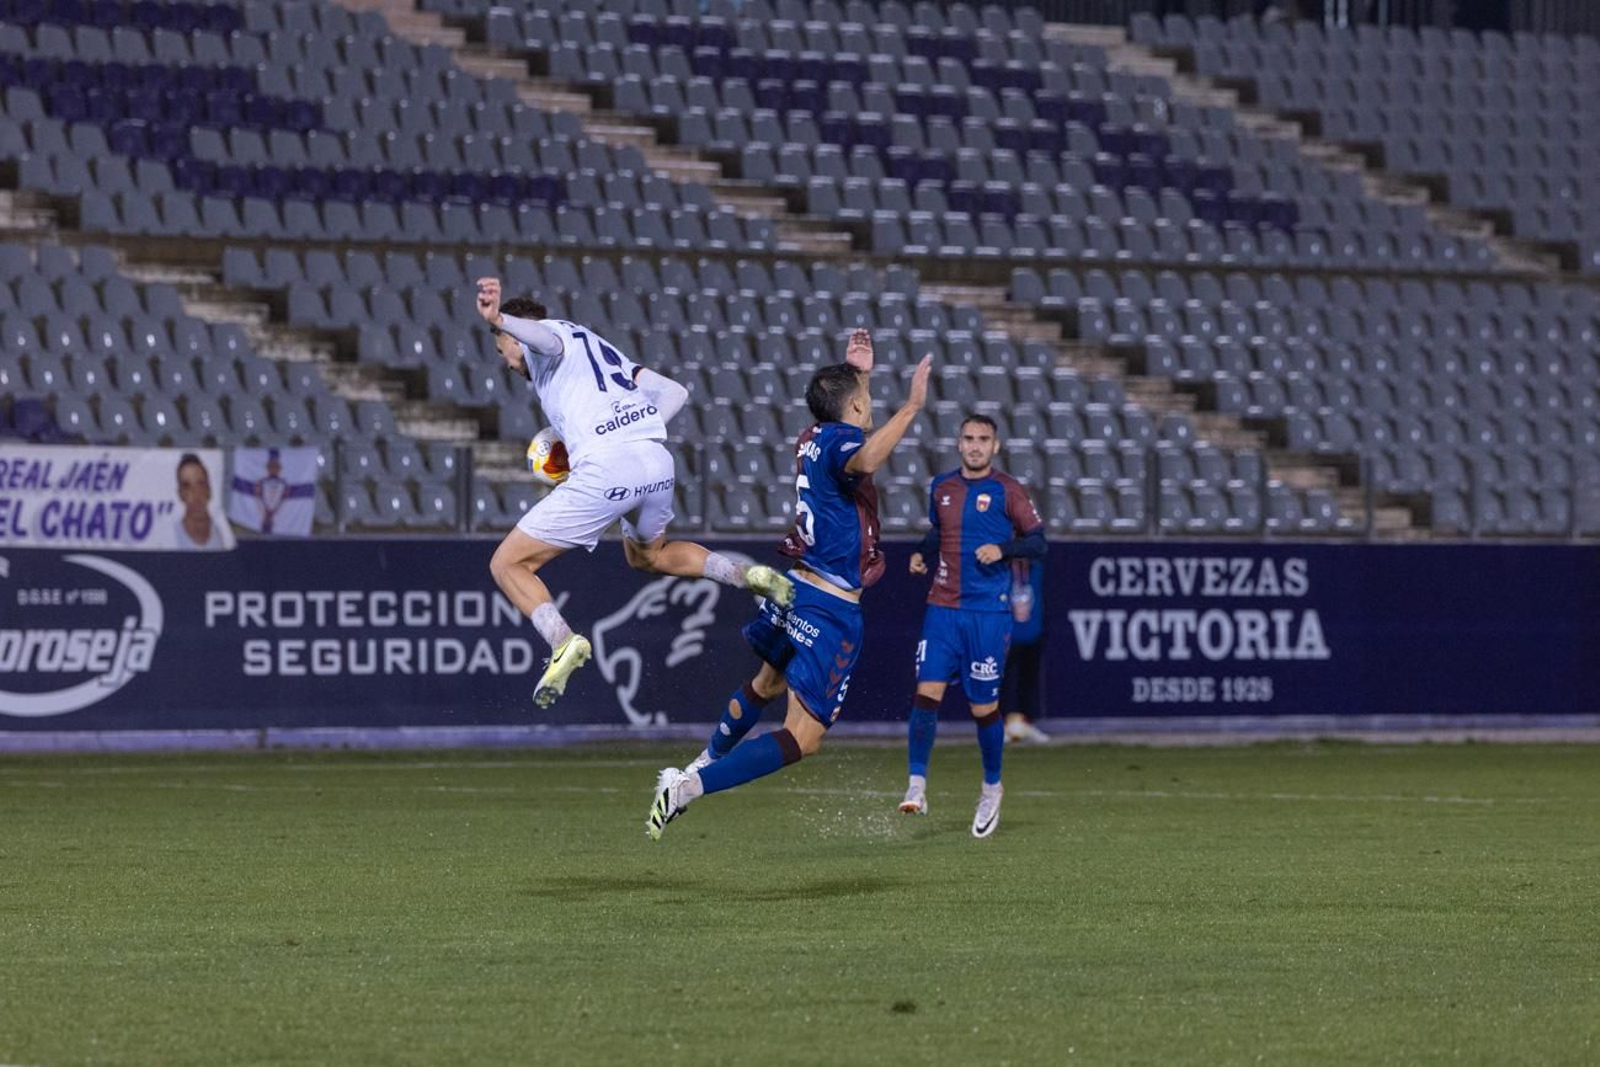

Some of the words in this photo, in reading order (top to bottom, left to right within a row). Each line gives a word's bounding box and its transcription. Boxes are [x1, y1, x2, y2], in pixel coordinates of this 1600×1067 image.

[58, 452, 130, 492] JAÉN
[1089, 557, 1309, 597] CERVEZAS
[204, 591, 522, 627] PROTECCION
[1067, 608, 1332, 661] VICTORIA
[243, 638, 534, 676] SEGURIDAD
[970, 661, 998, 675] CRC
[1132, 676, 1216, 703] DESDE
